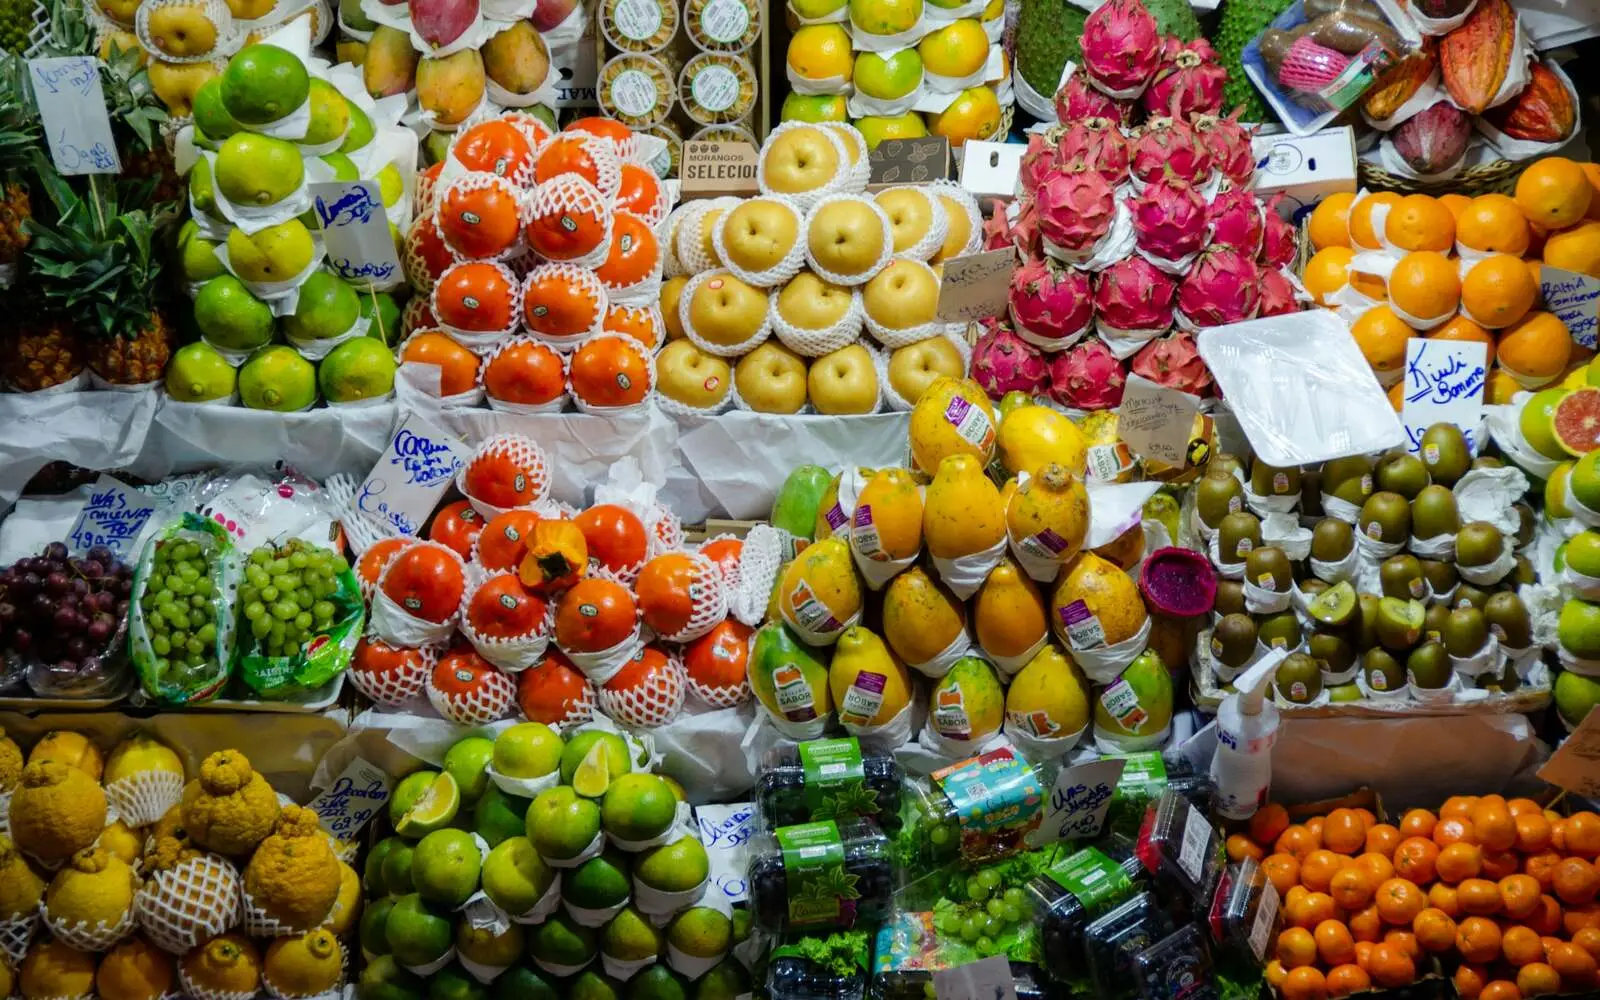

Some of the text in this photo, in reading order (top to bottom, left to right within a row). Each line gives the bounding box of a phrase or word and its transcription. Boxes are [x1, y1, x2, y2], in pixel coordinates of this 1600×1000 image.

[689, 154, 744, 162] MORANGOS
[1407, 342, 1467, 389] Kiwi
[1094, 448, 1109, 479] SABOR
[780, 691, 812, 705] SABOR
